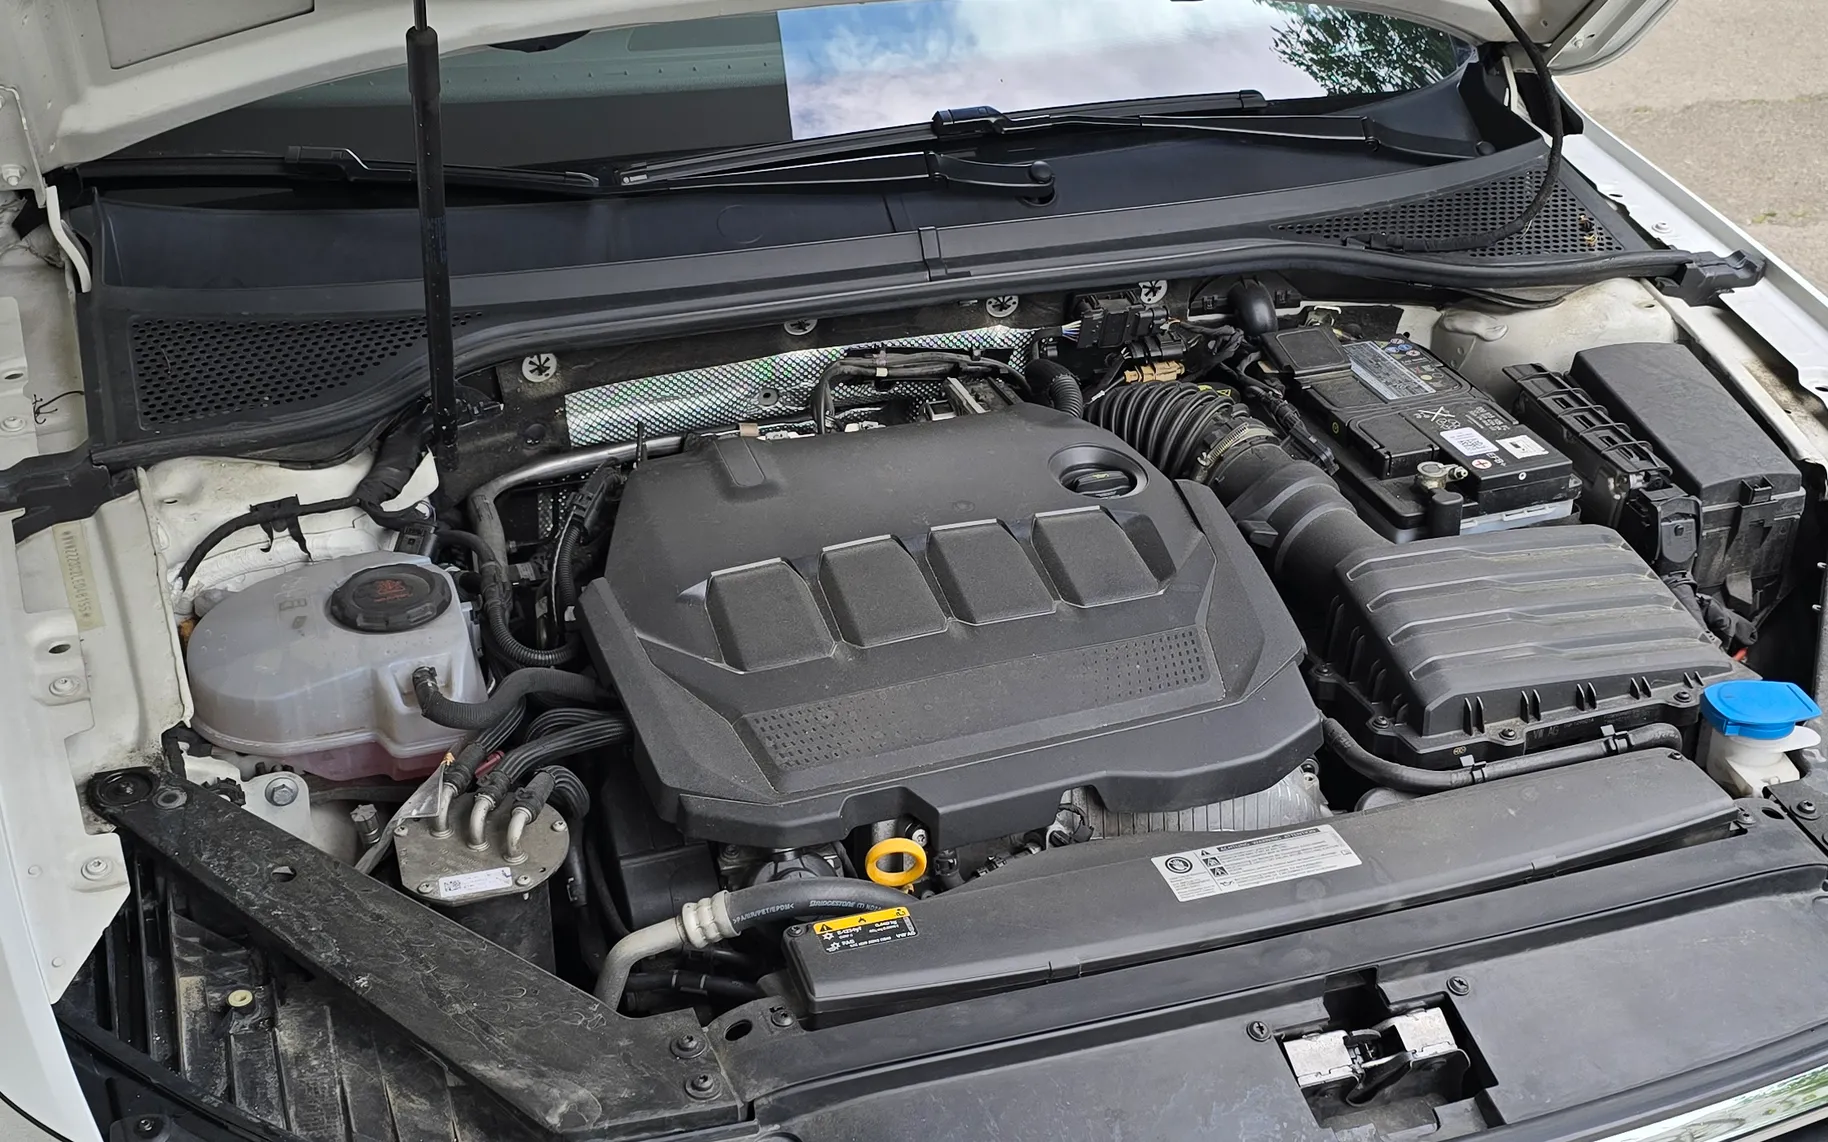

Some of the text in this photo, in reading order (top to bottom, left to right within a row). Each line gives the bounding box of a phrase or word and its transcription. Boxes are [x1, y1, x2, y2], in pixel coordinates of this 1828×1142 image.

[1220, 829, 1317, 851] ACHTUNG WARNING ATTENTION
